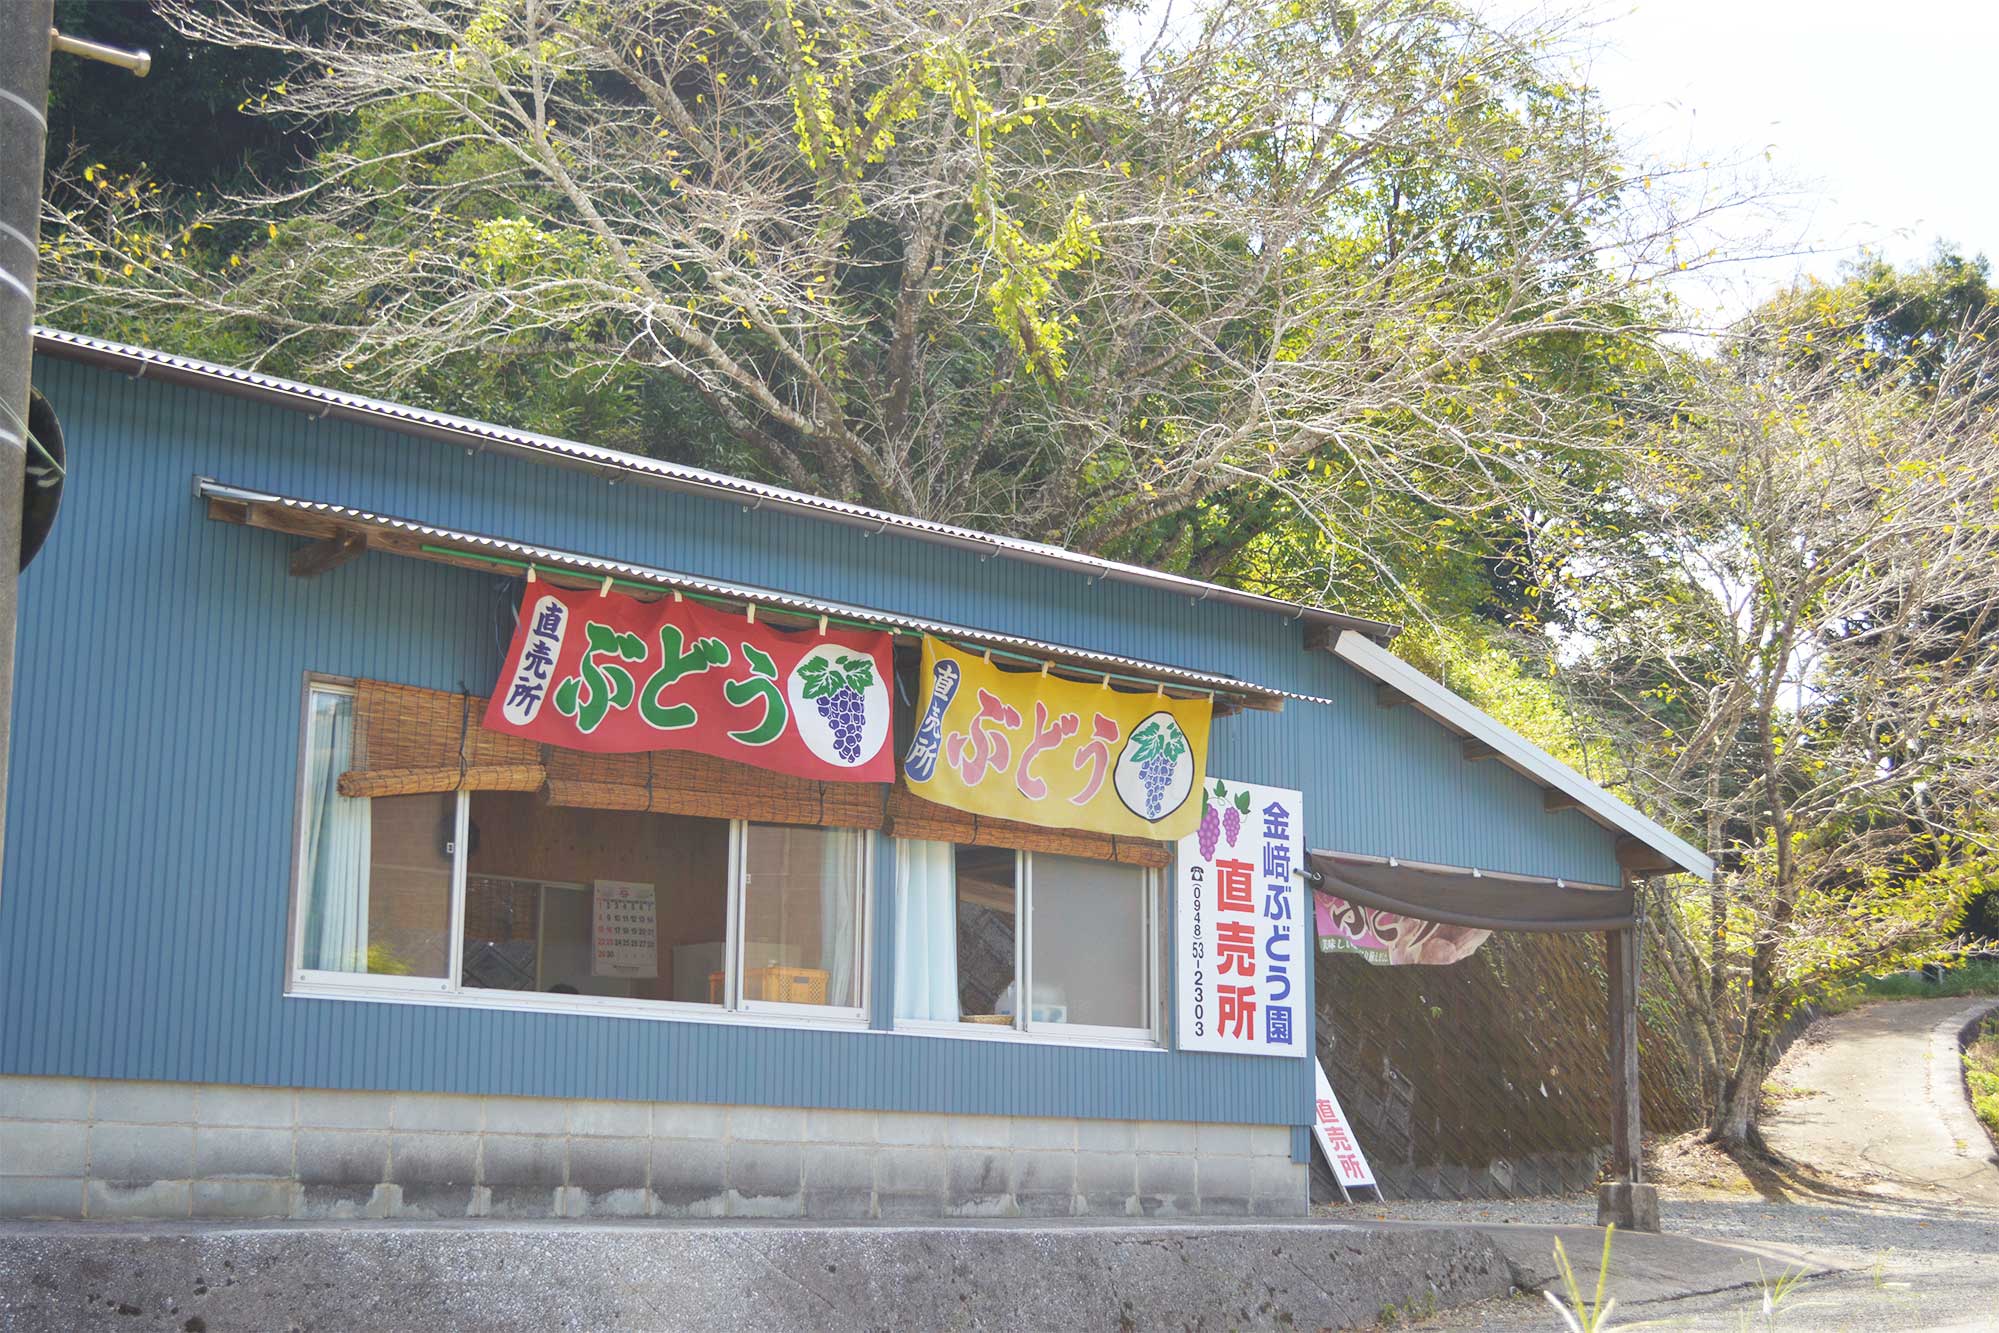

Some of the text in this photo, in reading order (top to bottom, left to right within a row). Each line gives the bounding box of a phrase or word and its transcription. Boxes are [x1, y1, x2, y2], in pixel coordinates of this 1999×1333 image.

[506, 601, 564, 717] 直売所
[554, 620, 789, 746] ぶどう
[906, 664, 958, 776] 直売所
[946, 688, 1120, 805] ぶどう
[1216, 858, 1257, 1041] 直売所
[1316, 1098, 1366, 1179] 直売所
